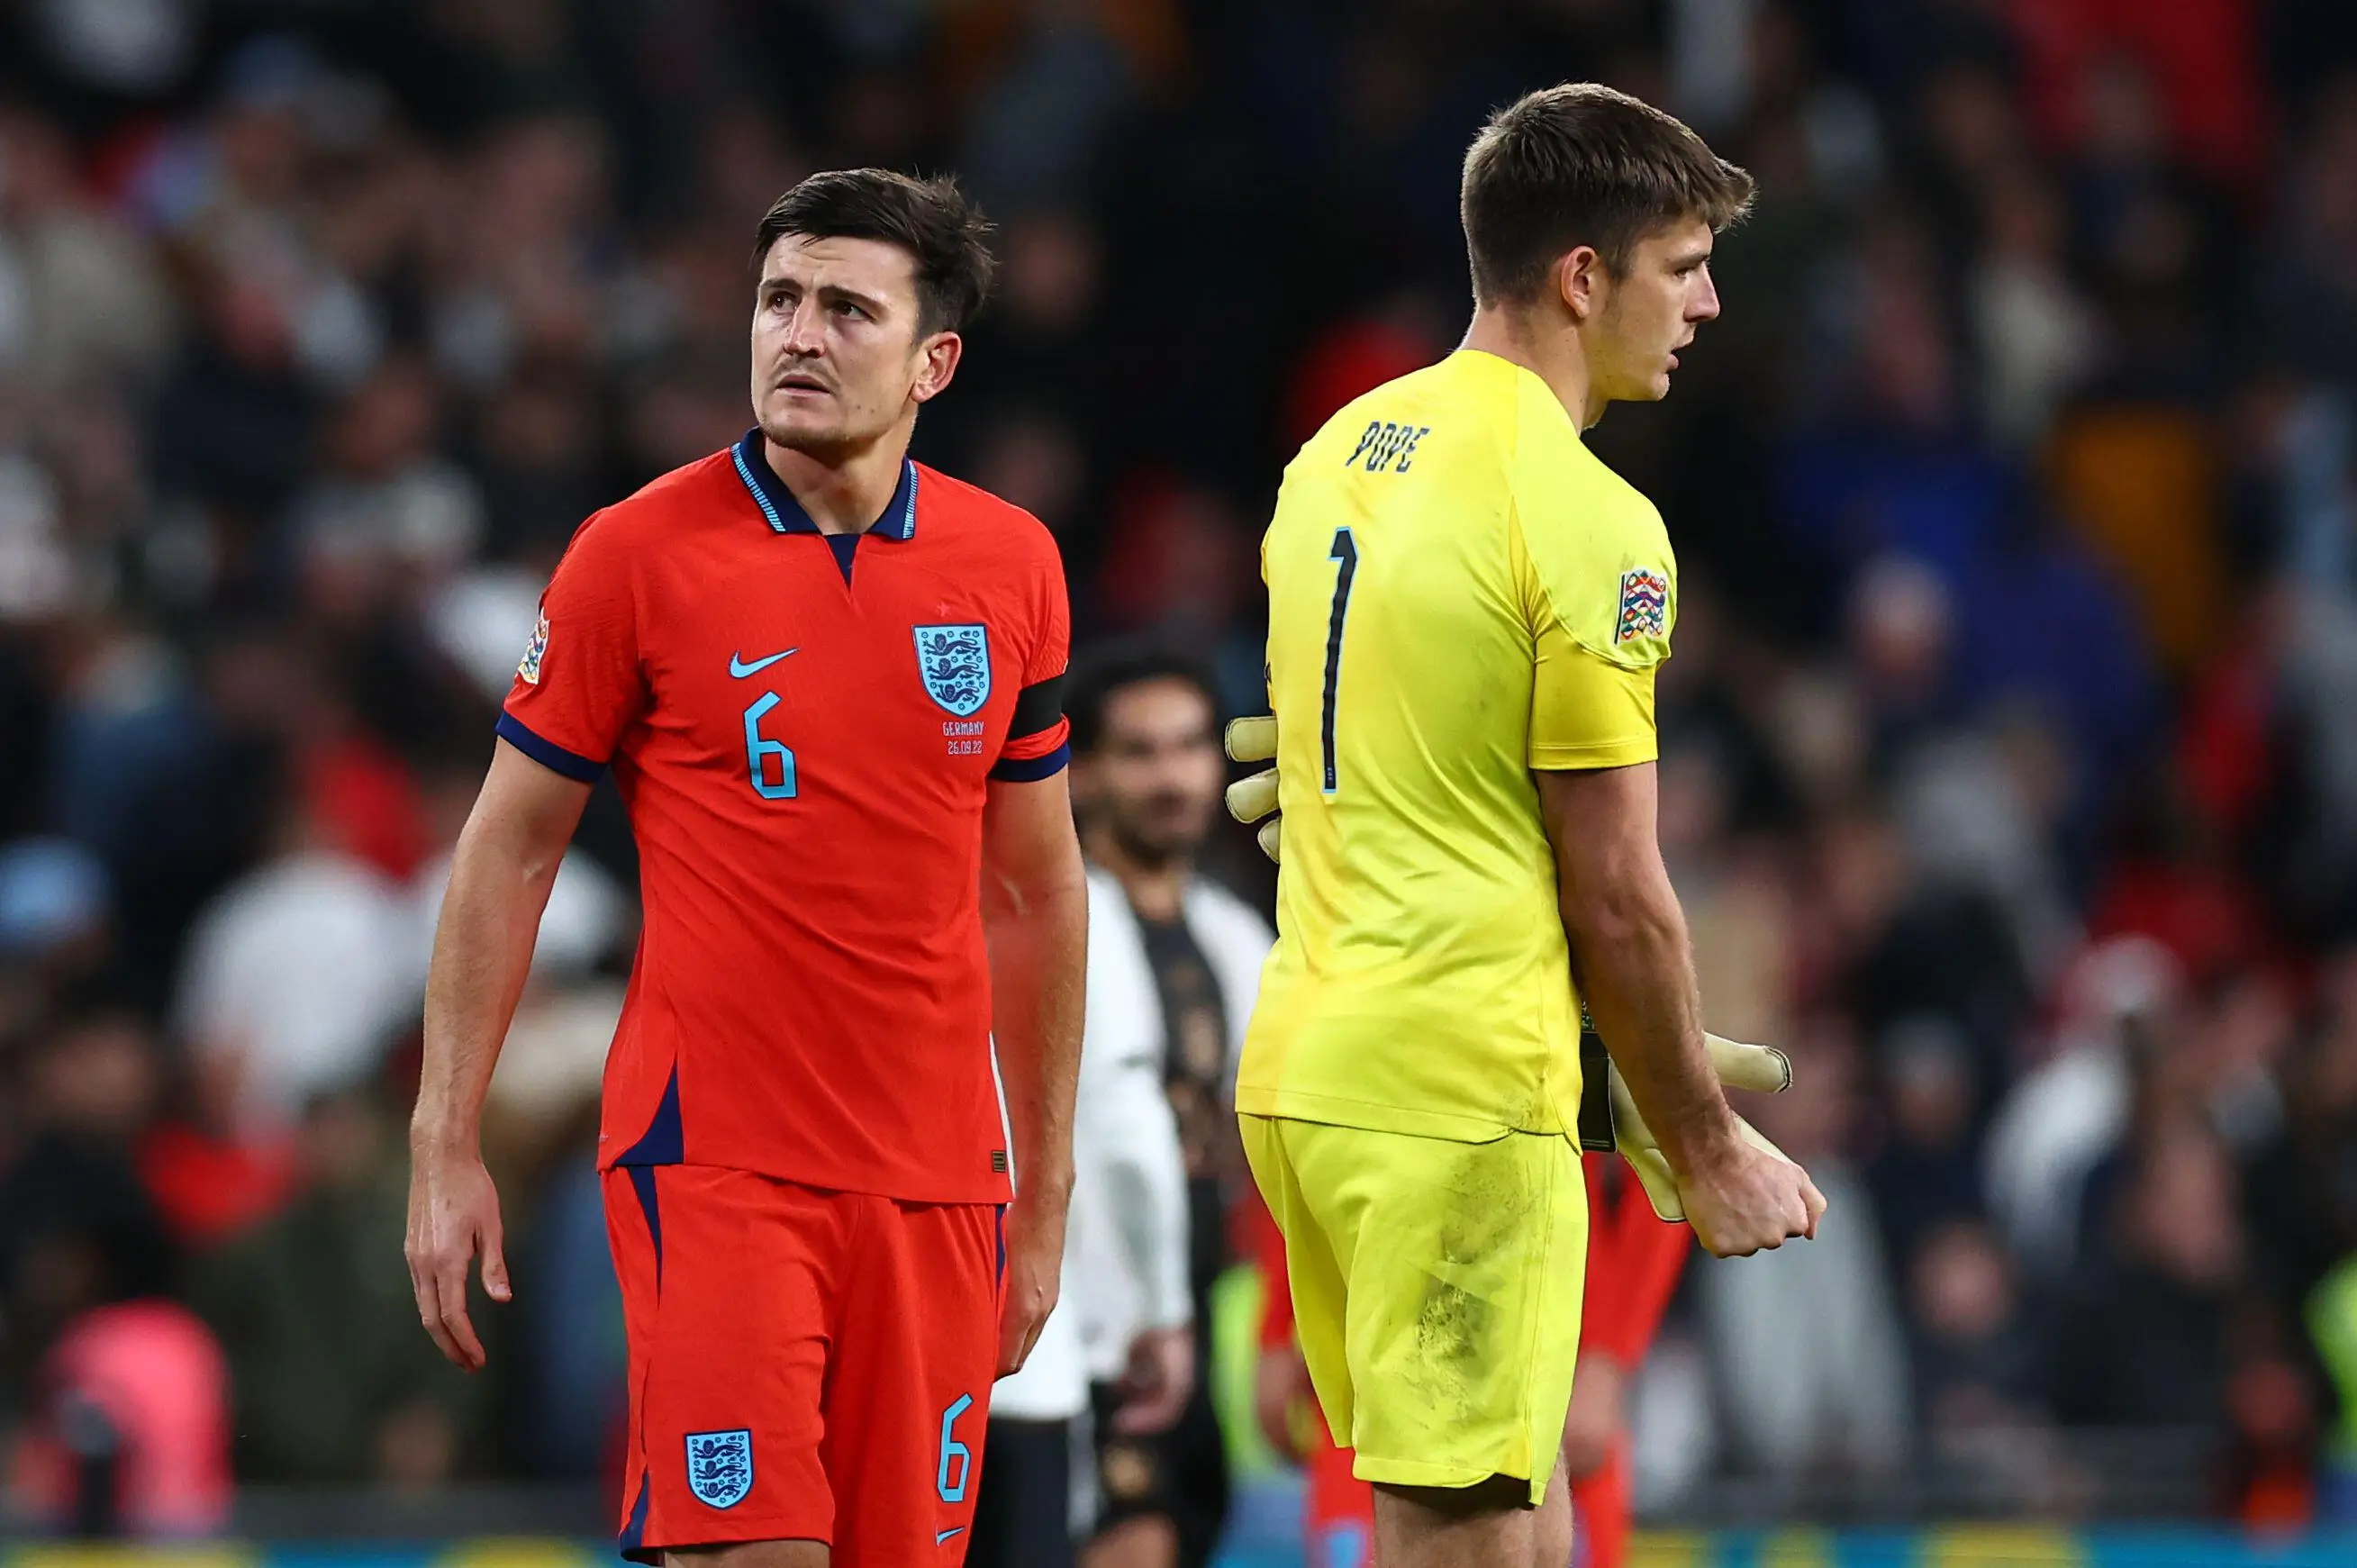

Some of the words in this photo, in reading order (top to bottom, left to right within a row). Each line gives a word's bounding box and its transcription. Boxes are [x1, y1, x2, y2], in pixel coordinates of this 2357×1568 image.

[1346, 421, 1430, 473] POPE
[1321, 526, 1358, 793] 1
[743, 690, 799, 800] 6
[942, 721, 984, 737] GERMANY
[947, 740, 983, 756] 26.09.22
[938, 1392, 974, 1503] 6
